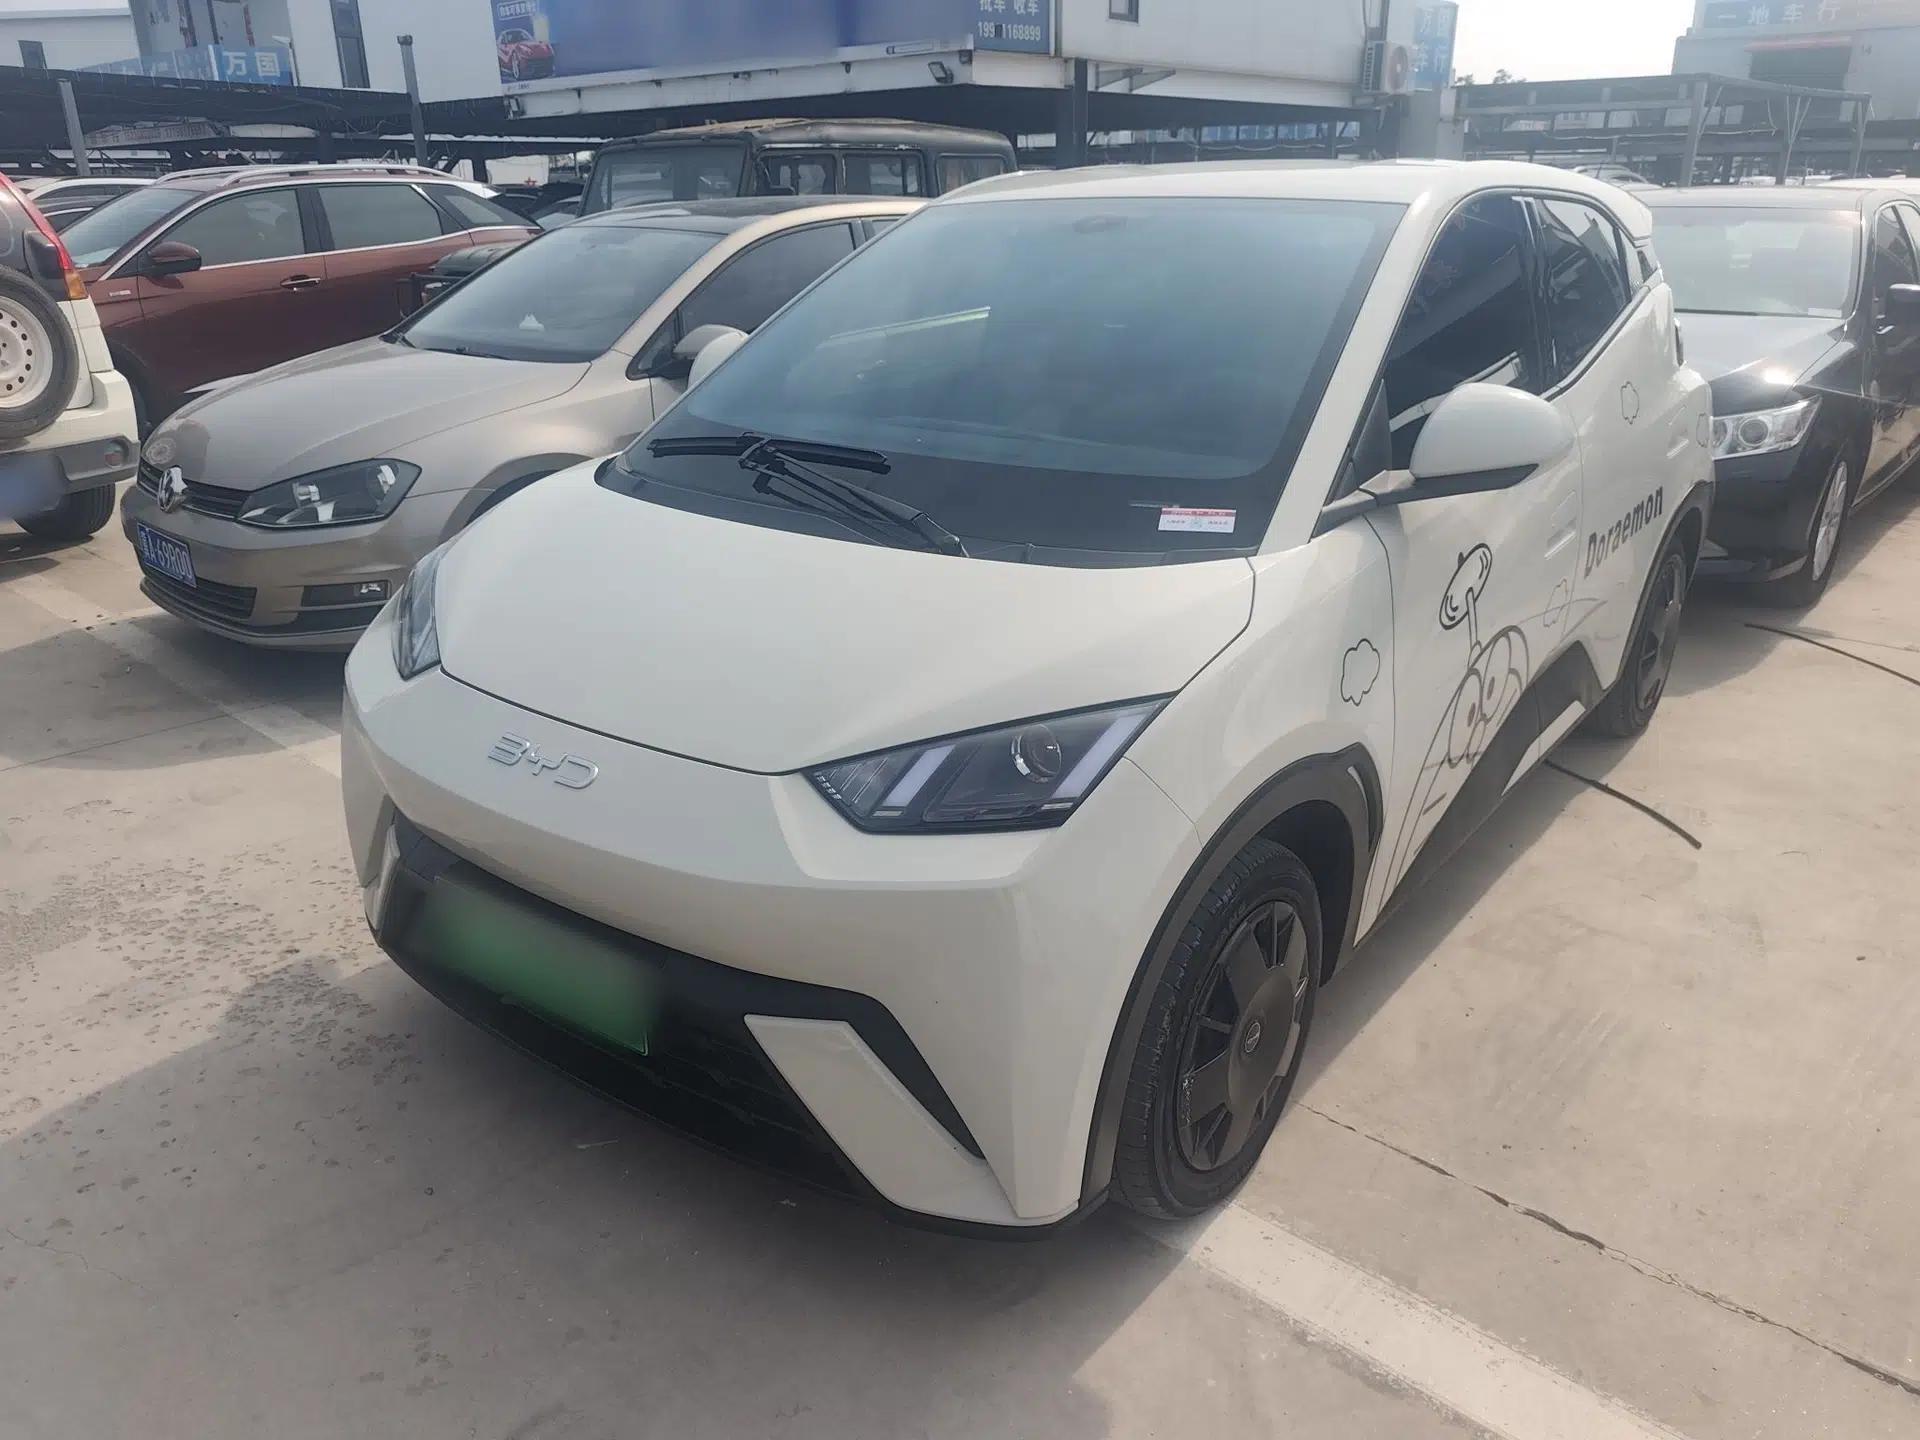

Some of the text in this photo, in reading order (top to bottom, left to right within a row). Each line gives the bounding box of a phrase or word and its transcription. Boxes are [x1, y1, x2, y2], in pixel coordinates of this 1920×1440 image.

[977, 22, 1041, 41] 1991168899
[222, 51, 281, 77] 万国
[1584, 486, 1663, 580] Doraemon
[487, 731, 599, 790] BYD
